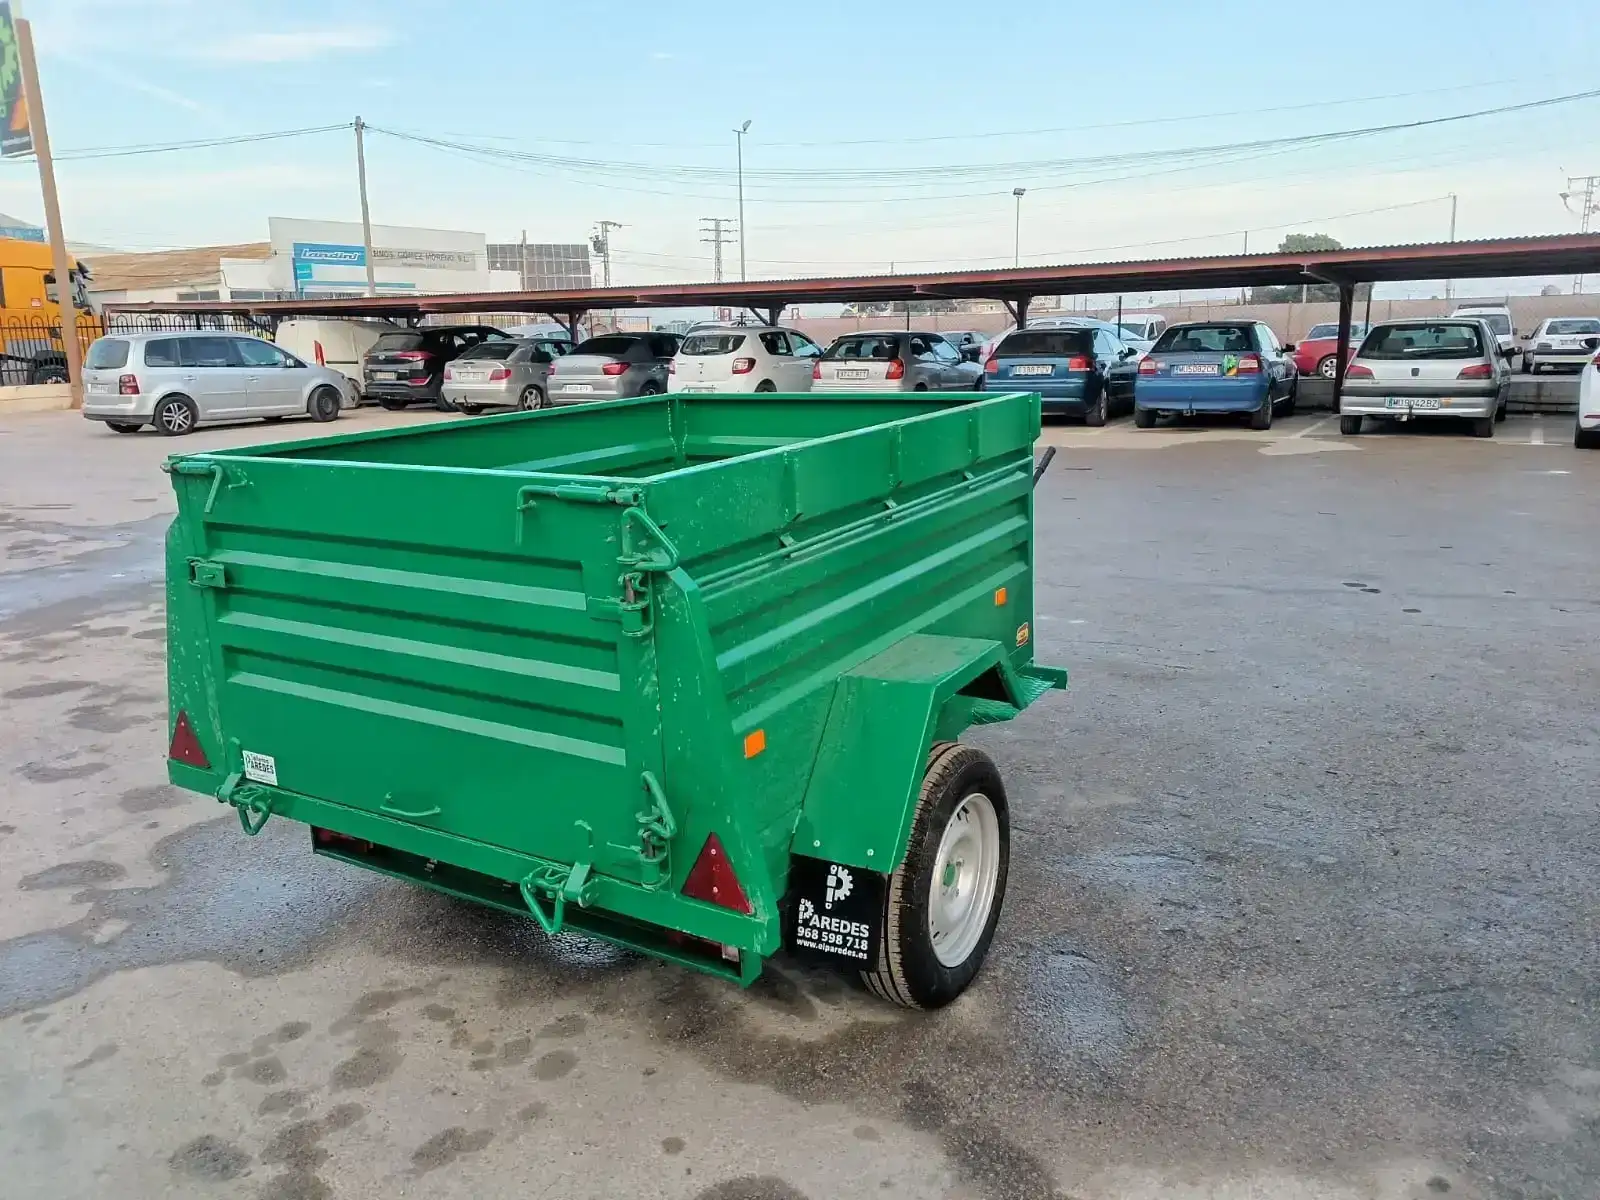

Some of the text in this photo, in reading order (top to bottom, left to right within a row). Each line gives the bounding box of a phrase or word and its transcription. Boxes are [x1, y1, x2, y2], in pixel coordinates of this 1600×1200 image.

[797, 926, 868, 951] 968 598 718
